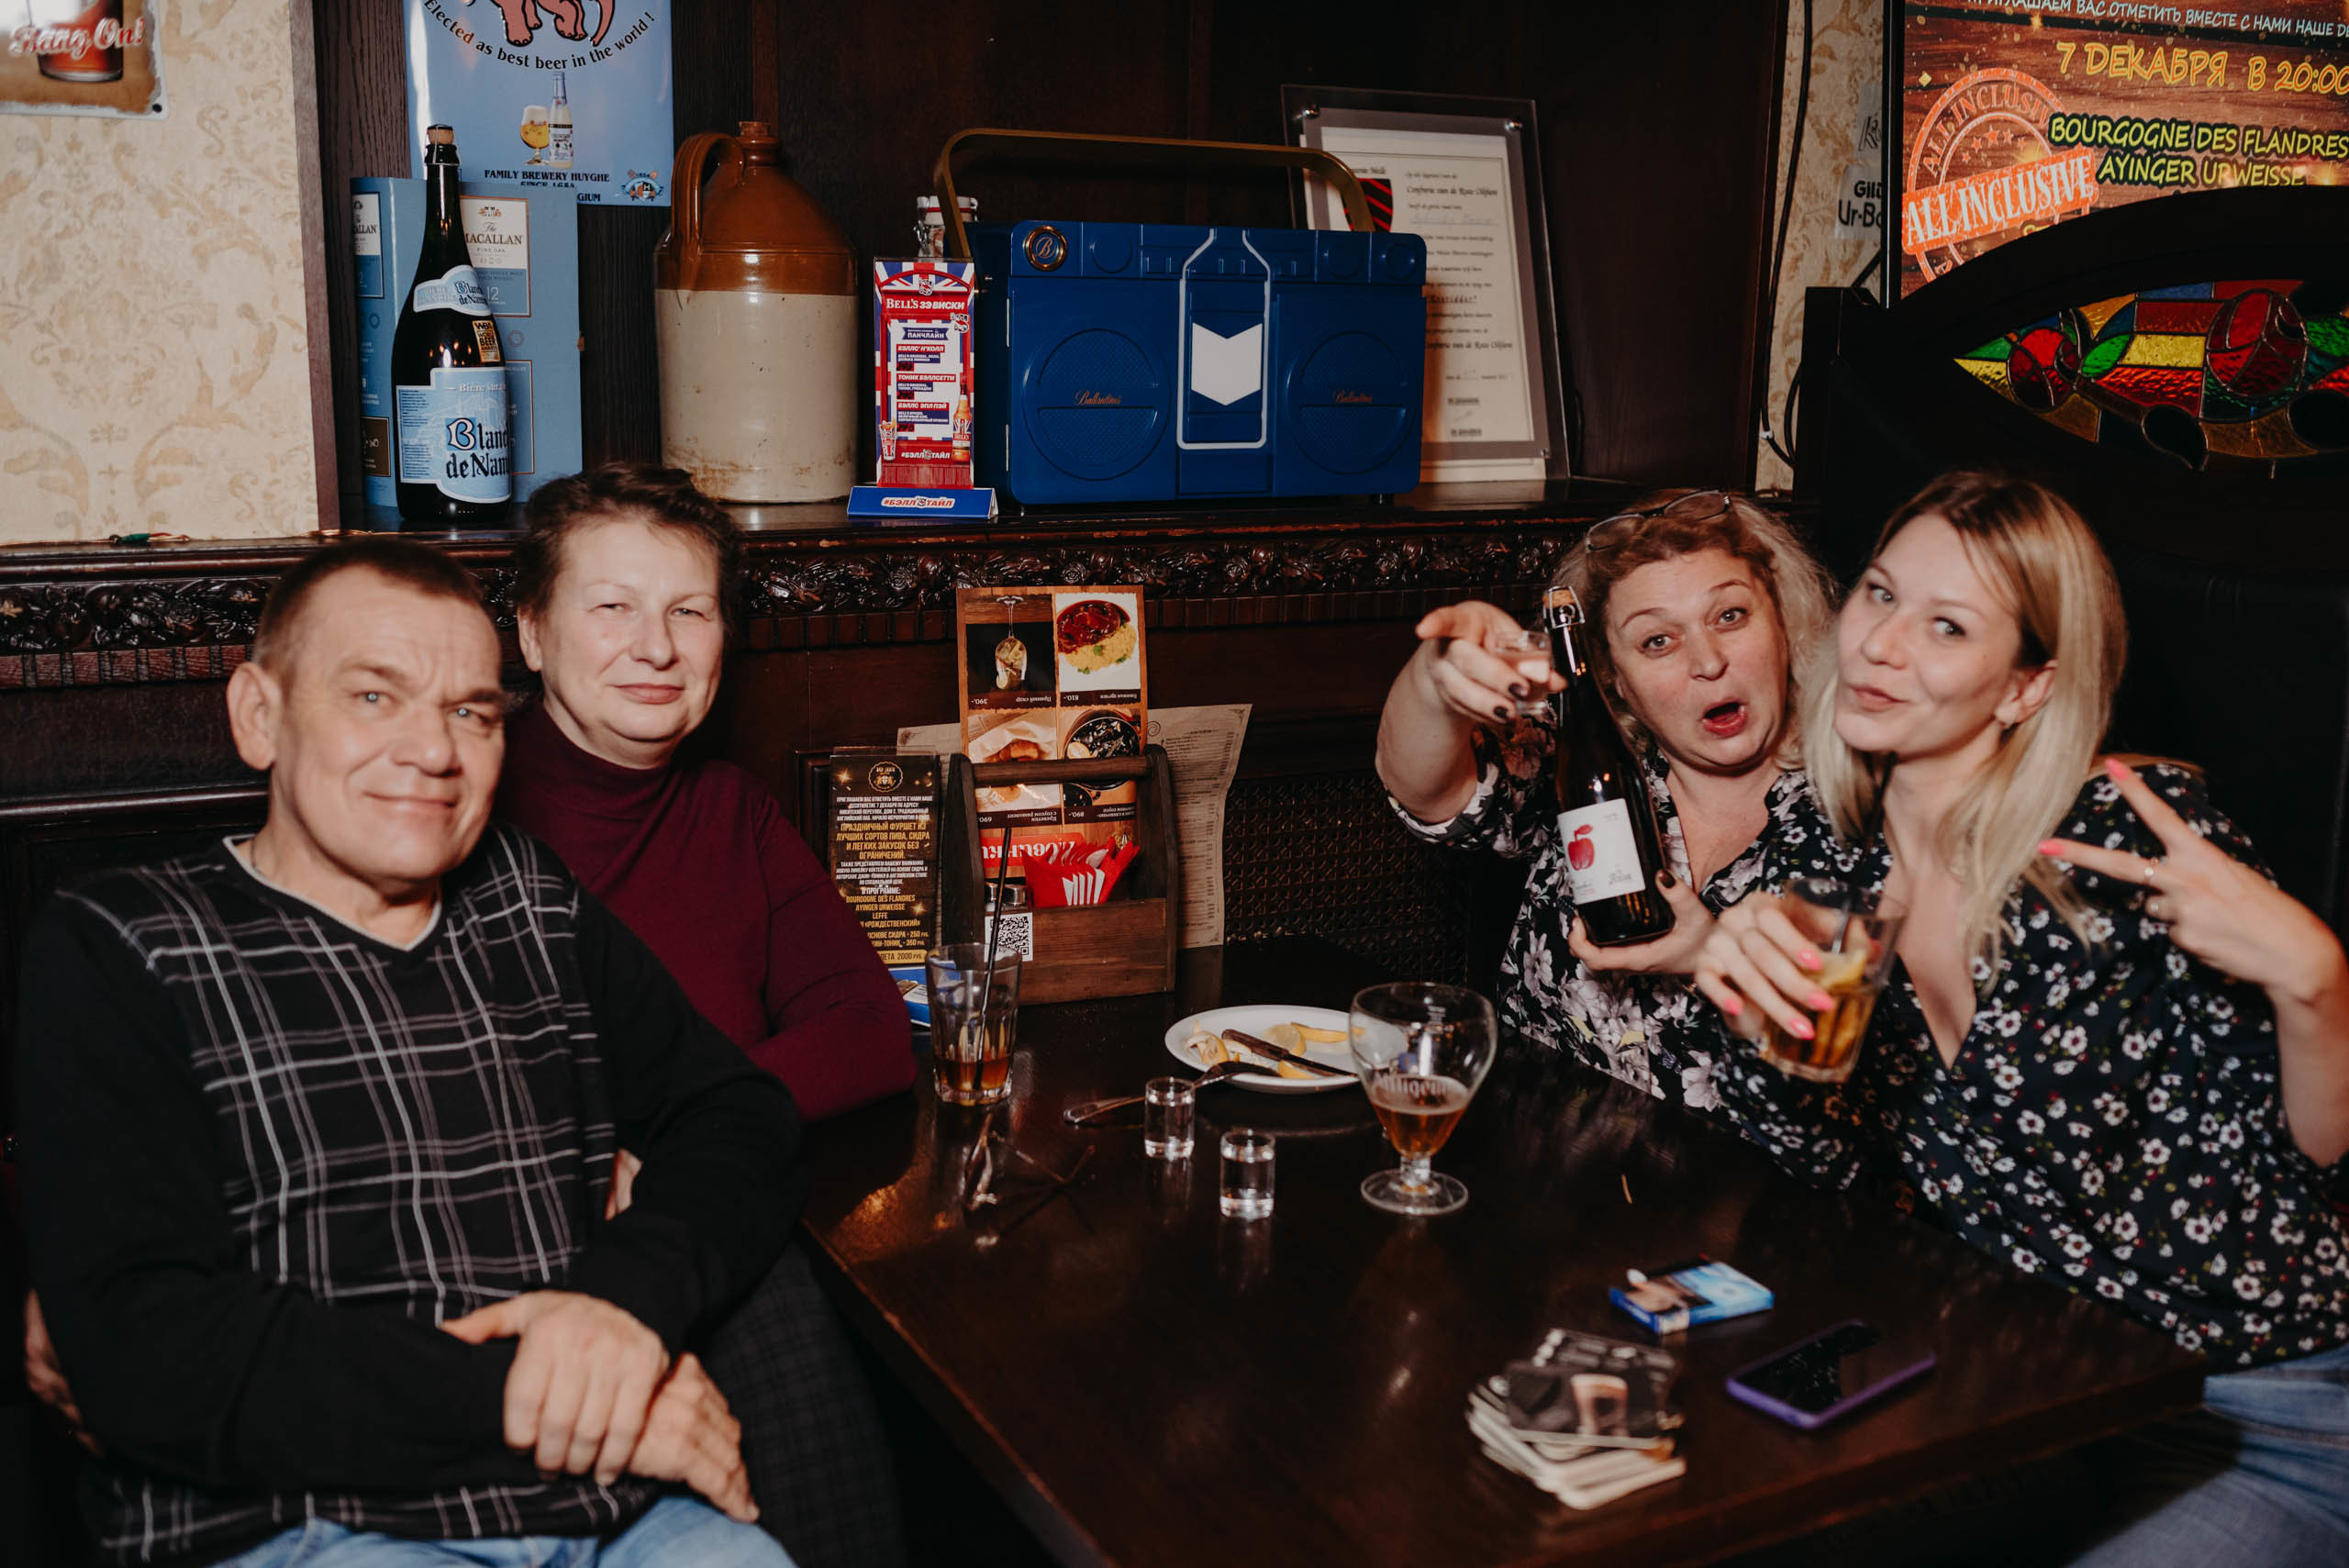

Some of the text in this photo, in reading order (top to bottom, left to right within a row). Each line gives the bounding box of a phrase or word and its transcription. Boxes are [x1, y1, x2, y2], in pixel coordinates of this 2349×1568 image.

[1967, 0, 2334, 36] ГЛАШАЕМ ВАС ОТМЕТИТЬ ВМЕСТЕ С НАМИ НАШЕ
[424, 0, 474, 44] Elected
[475, 40, 493, 55] as
[497, 48, 529, 67] best
[535, 55, 568, 70] beer
[572, 53, 586, 68] in
[589, 47, 613, 63] the
[614, 18, 650, 51] world
[2056, 42, 2076, 74] 7
[2085, 42, 2229, 87] ДЕКАБРЯ
[2248, 56, 2267, 91] В
[1951, 83, 2049, 128] INCLUSIV
[2051, 116, 2349, 157] BOURGOGNE DES FLANDRES
[2099, 155, 2196, 184] AYINGER
[484, 170, 610, 183] FAMILY BREWERY HUYGHE
[576, 193, 601, 202] GIUM
[1907, 155, 2094, 247] ALL INCLUSIVE
[486, 286, 499, 300] 12
[886, 298, 918, 309] BELL'S
[932, 301, 965, 310] ВИСКИ
[907, 330, 944, 339] ПАНЧЛАЙН
[446, 452, 469, 479] de
[841, 821, 927, 831] ПРАЗДНИЧНЫЙ ФУРШЕТ ИЗ
[836, 831, 930, 841] ЛУЧШИХ СОРТОВ ПИВА, СИДРА
[846, 842, 852, 851] И
[852, 842, 877, 851] ЛЕГКИХ
[859, 851, 906, 860] ОГРАНИЧЕНИЙ.
[866, 886, 901, 895] ПРОГРАММЕ:
[880, 952, 895, 961] ЛЕТА
